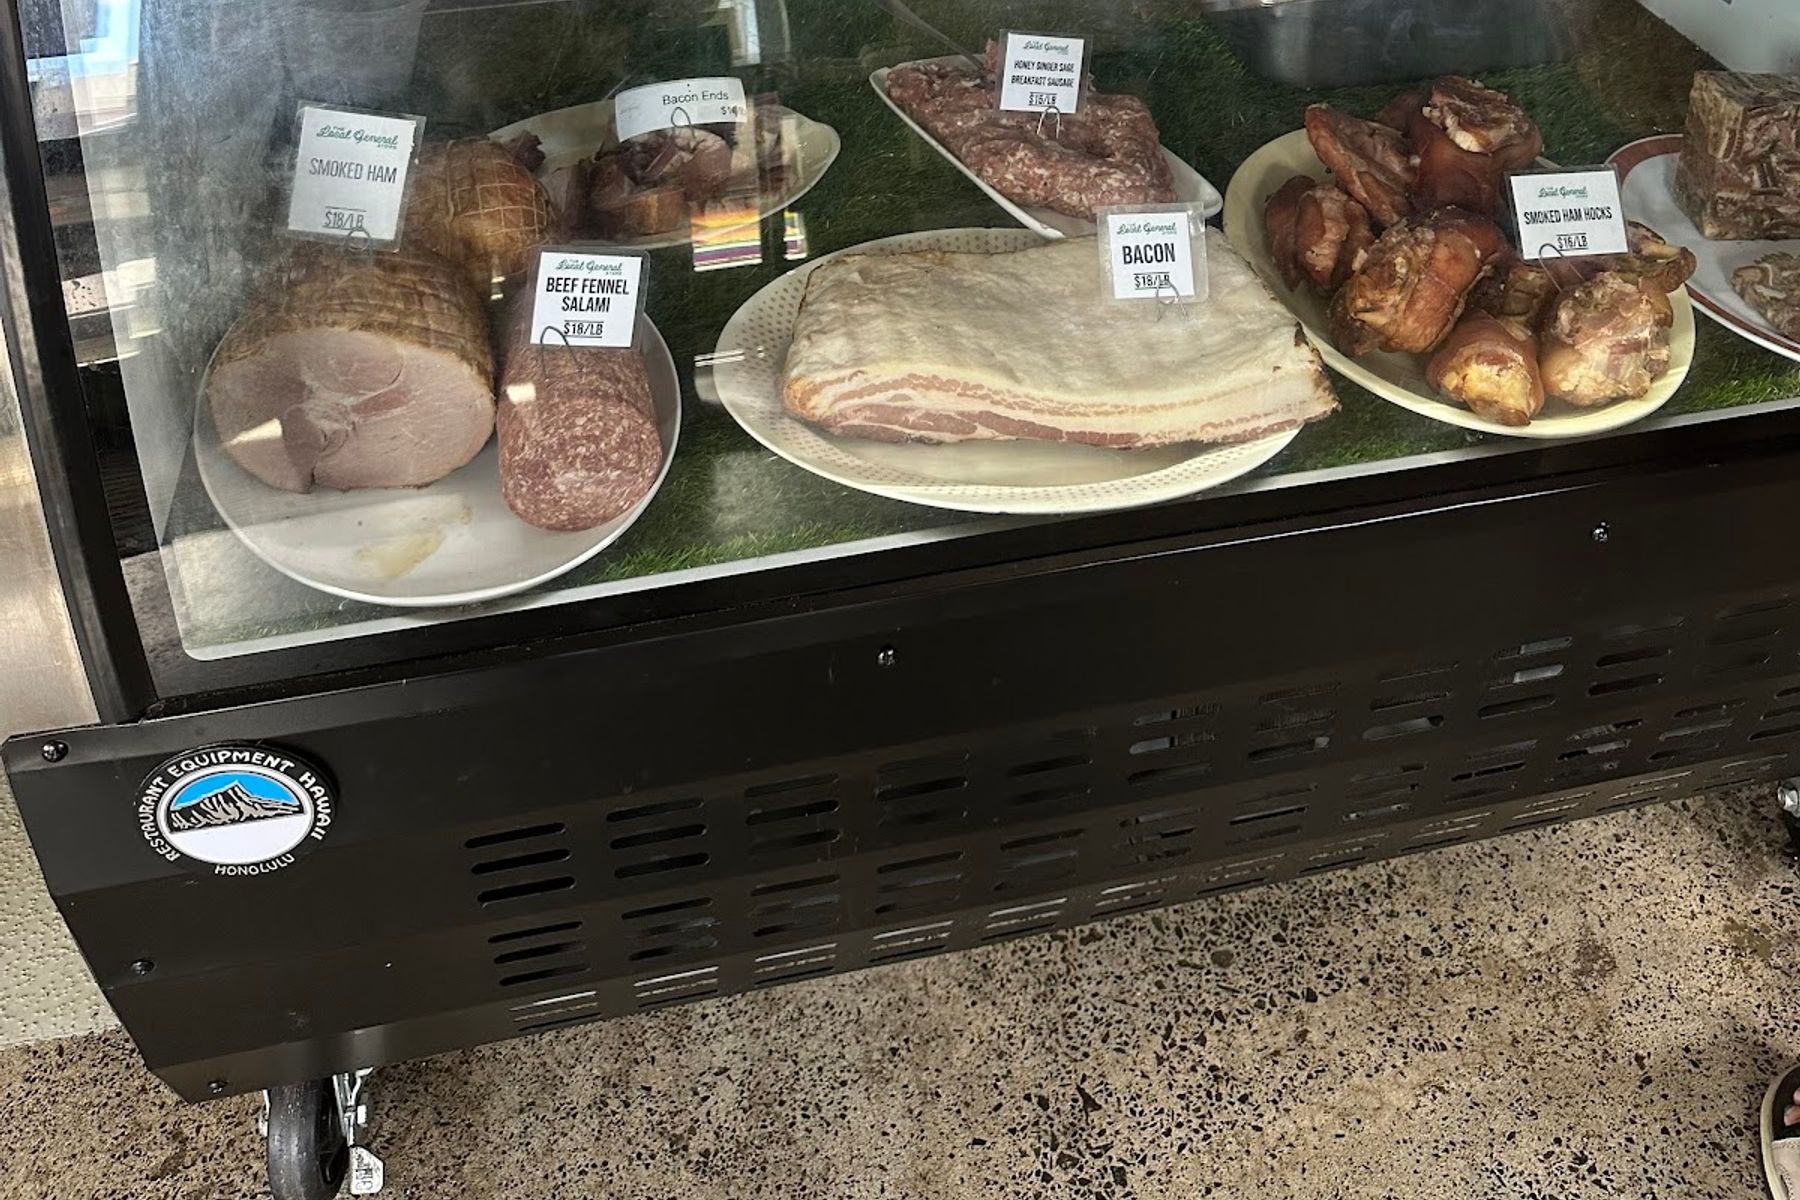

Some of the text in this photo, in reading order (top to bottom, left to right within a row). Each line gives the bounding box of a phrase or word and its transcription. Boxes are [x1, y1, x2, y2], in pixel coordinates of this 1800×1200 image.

[1014, 60, 1035, 70] HONEY
[1059, 63, 1074, 73] SAGE
[1011, 75, 1074, 88] BREAKFAST SAUSAGE
[663, 90, 729, 105] Bacon Ends
[316, 125, 399, 144] Local General
[309, 157, 397, 184] SMOKED HAM
[324, 211, 365, 229] $18/LB
[1524, 206, 1612, 225] SMOKED HAM HOCKS
[1117, 222, 1177, 235] Local General
[1122, 243, 1176, 265] BACON
[555, 259, 622, 274] Local General
[546, 277, 629, 295] BEEF FENNEL
[562, 296, 610, 312] SALAMI
[563, 322, 603, 335] $18/LB
[138, 750, 331, 862] RESTAURANT EQUIPMENT HAWAII
[214, 853, 295, 876] HONOLULU
